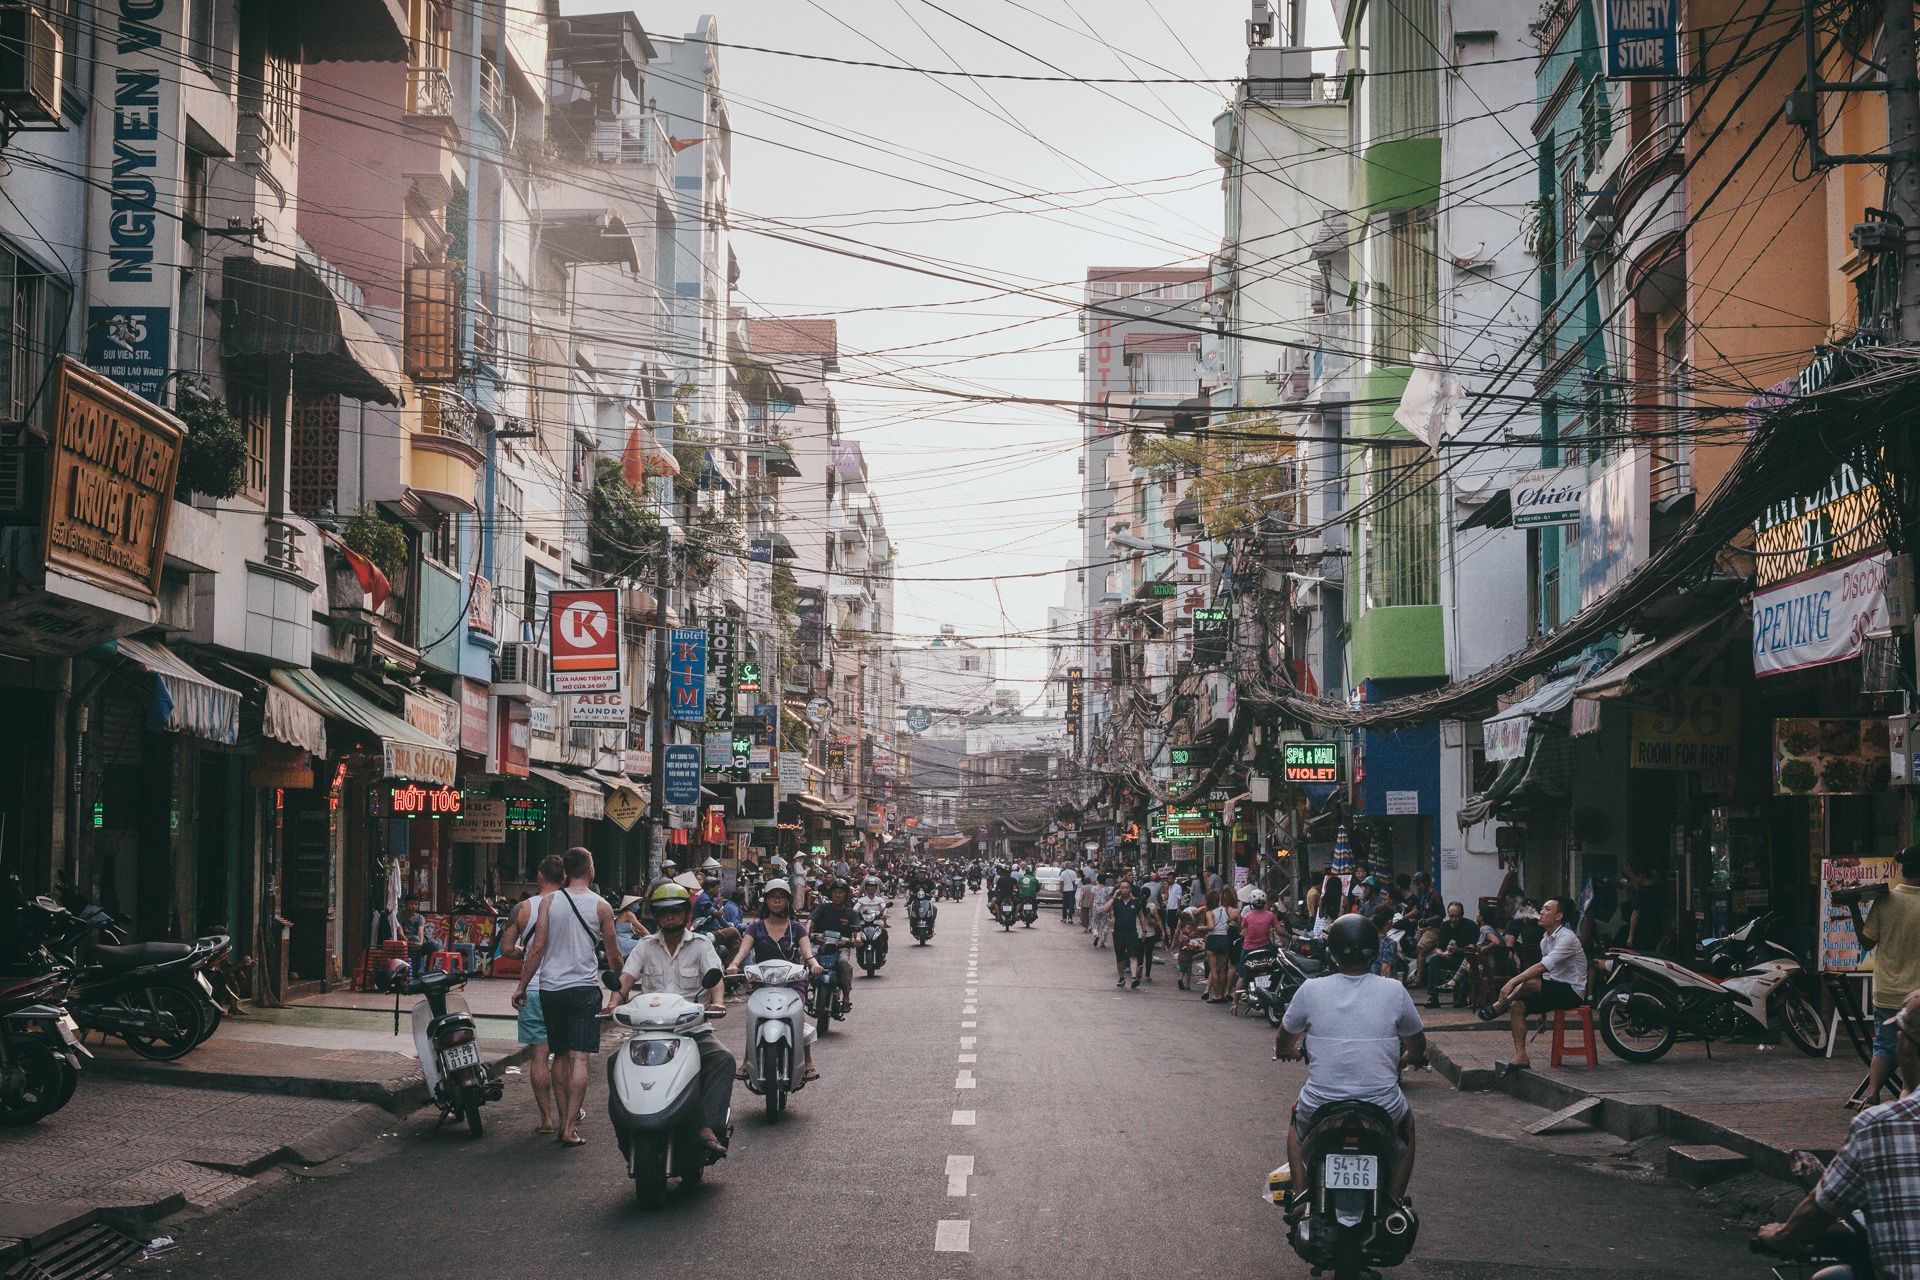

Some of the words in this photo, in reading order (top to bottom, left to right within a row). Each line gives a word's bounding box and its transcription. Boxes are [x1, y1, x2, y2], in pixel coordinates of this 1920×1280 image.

[1610, 0, 1670, 30] VARIETY
[1618, 37, 1664, 69] STORE
[1097, 319, 1112, 434] HOTEL
[63, 392, 118, 469] ROOM
[110, 421, 141, 479] FOR
[135, 434, 174, 493] RENT
[674, 630, 704, 640] Hotel
[676, 641, 700, 708] KIM
[577, 693, 622, 706] ABC
[573, 707, 625, 715] LAUNDRY
[1652, 692, 1723, 736] 96
[395, 748, 411, 773] BIA
[1287, 747, 1305, 764] SPA
[1306, 751, 1313, 764] &
[1314, 747, 1335, 764] NAIL
[1638, 741, 1671, 764] ROOM
[1675, 742, 1697, 765] FOR
[1701, 743, 1730, 766] RENT
[708, 755, 747, 772] pa
[1287, 768, 1335, 779] VIOLET
[394, 785, 426, 811] HỚT
[429, 786, 461, 812] TÓC
[1209, 790, 1230, 800] SPA
[465, 803, 492, 812] ABC
[514, 800, 533, 808] ABC
[526, 808, 544, 820] DRY
[453, 819, 478, 827] LAUN
[482, 820, 503, 828] DRY
[1823, 861, 1878, 881] Discount
[1823, 920, 1842, 935] Body
[1822, 955, 1857, 967] Pedicure
[451, 1053, 474, 1068] 0137
[1333, 1158, 1370, 1171] 54-T2
[1333, 1172, 1370, 1187] 7666
